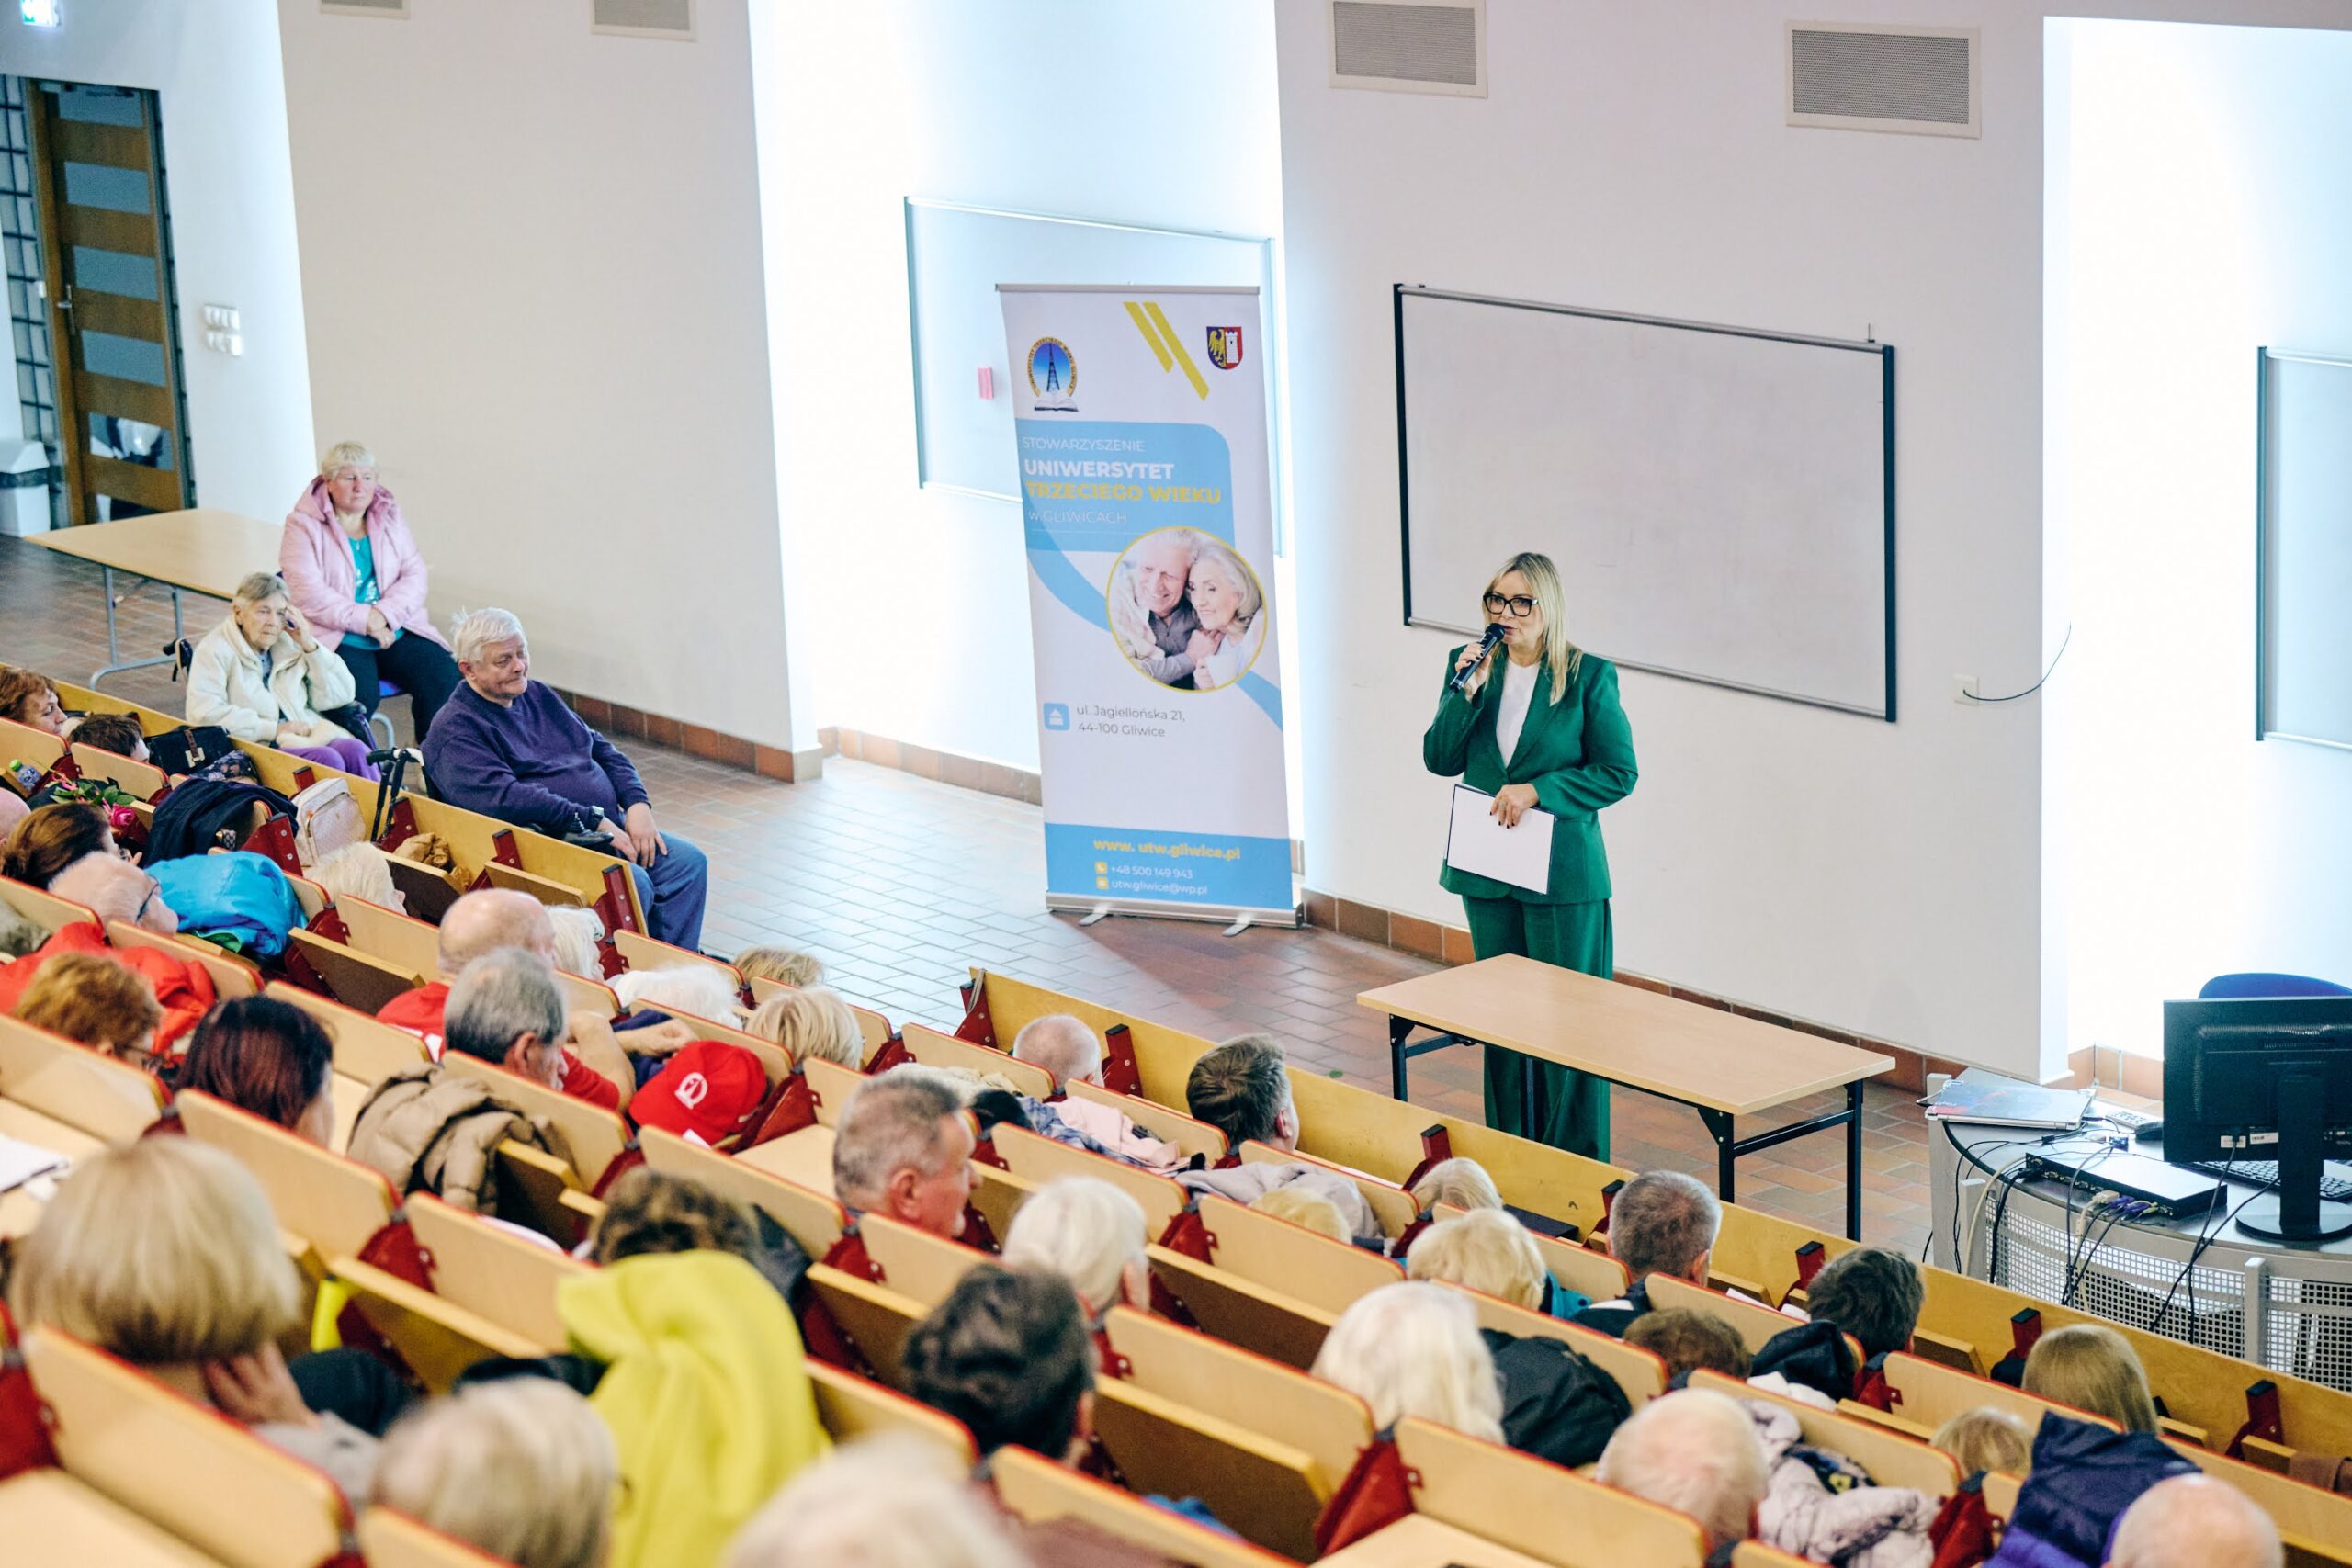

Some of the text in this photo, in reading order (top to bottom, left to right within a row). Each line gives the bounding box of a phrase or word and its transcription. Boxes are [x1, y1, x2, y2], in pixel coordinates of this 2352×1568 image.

[1023, 436, 1146, 452] STOWARZYSZENIE
[1024, 459, 1174, 479] UNIWERSYTET
[1025, 480, 1221, 504] TRZECIEGO WIEKU
[1043, 510, 1127, 524] GLIWICACH
[1094, 705, 1168, 719] Jagiellońska
[1171, 710, 1186, 722] 21,
[1078, 723, 1166, 737] 44-100 Gliwice
[1093, 840, 1241, 861] www. utw.gliwice.pl
[1112, 865, 1130, 875] +48
[1132, 866, 1151, 876] 500
[1154, 868, 1171, 878] 149
[1112, 881, 1208, 896] utw.gliwice@wp.pl
